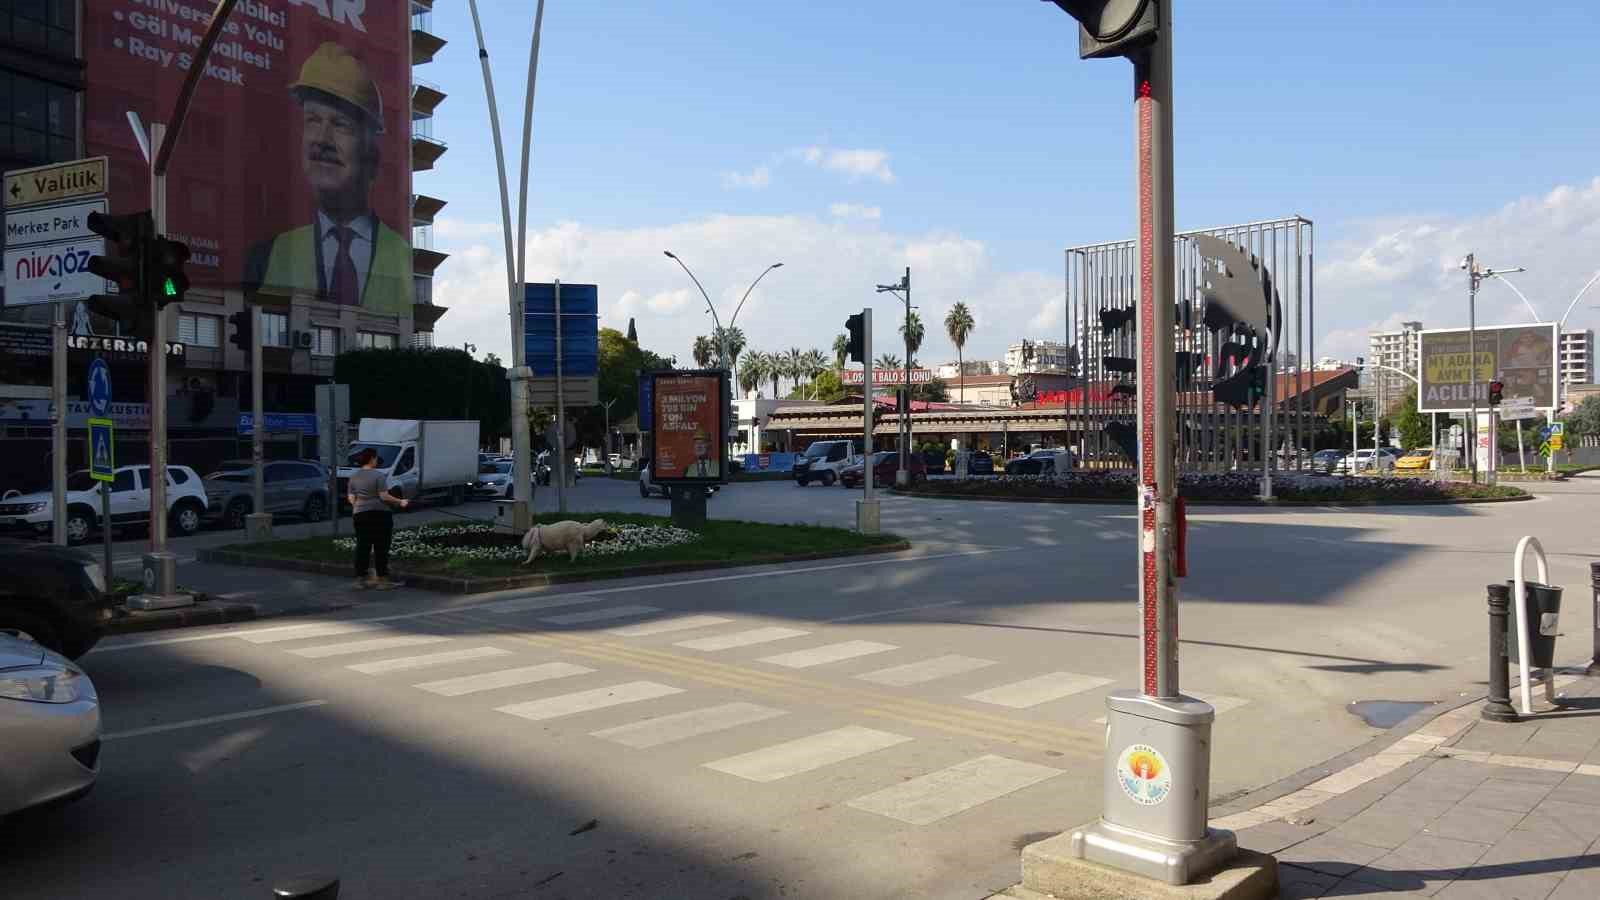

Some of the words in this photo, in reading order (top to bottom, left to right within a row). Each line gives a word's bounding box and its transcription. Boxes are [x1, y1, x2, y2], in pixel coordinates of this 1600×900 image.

[129, 11, 167, 38] Göl
[244, 23, 284, 51] Yolu
[128, 36, 175, 68] Ray
[176, 51, 244, 86] Skak
[34, 170, 97, 194] Valilik
[7, 221, 49, 237] Merkez
[53, 215, 80, 231] Park
[879, 372, 898, 382] BALO
